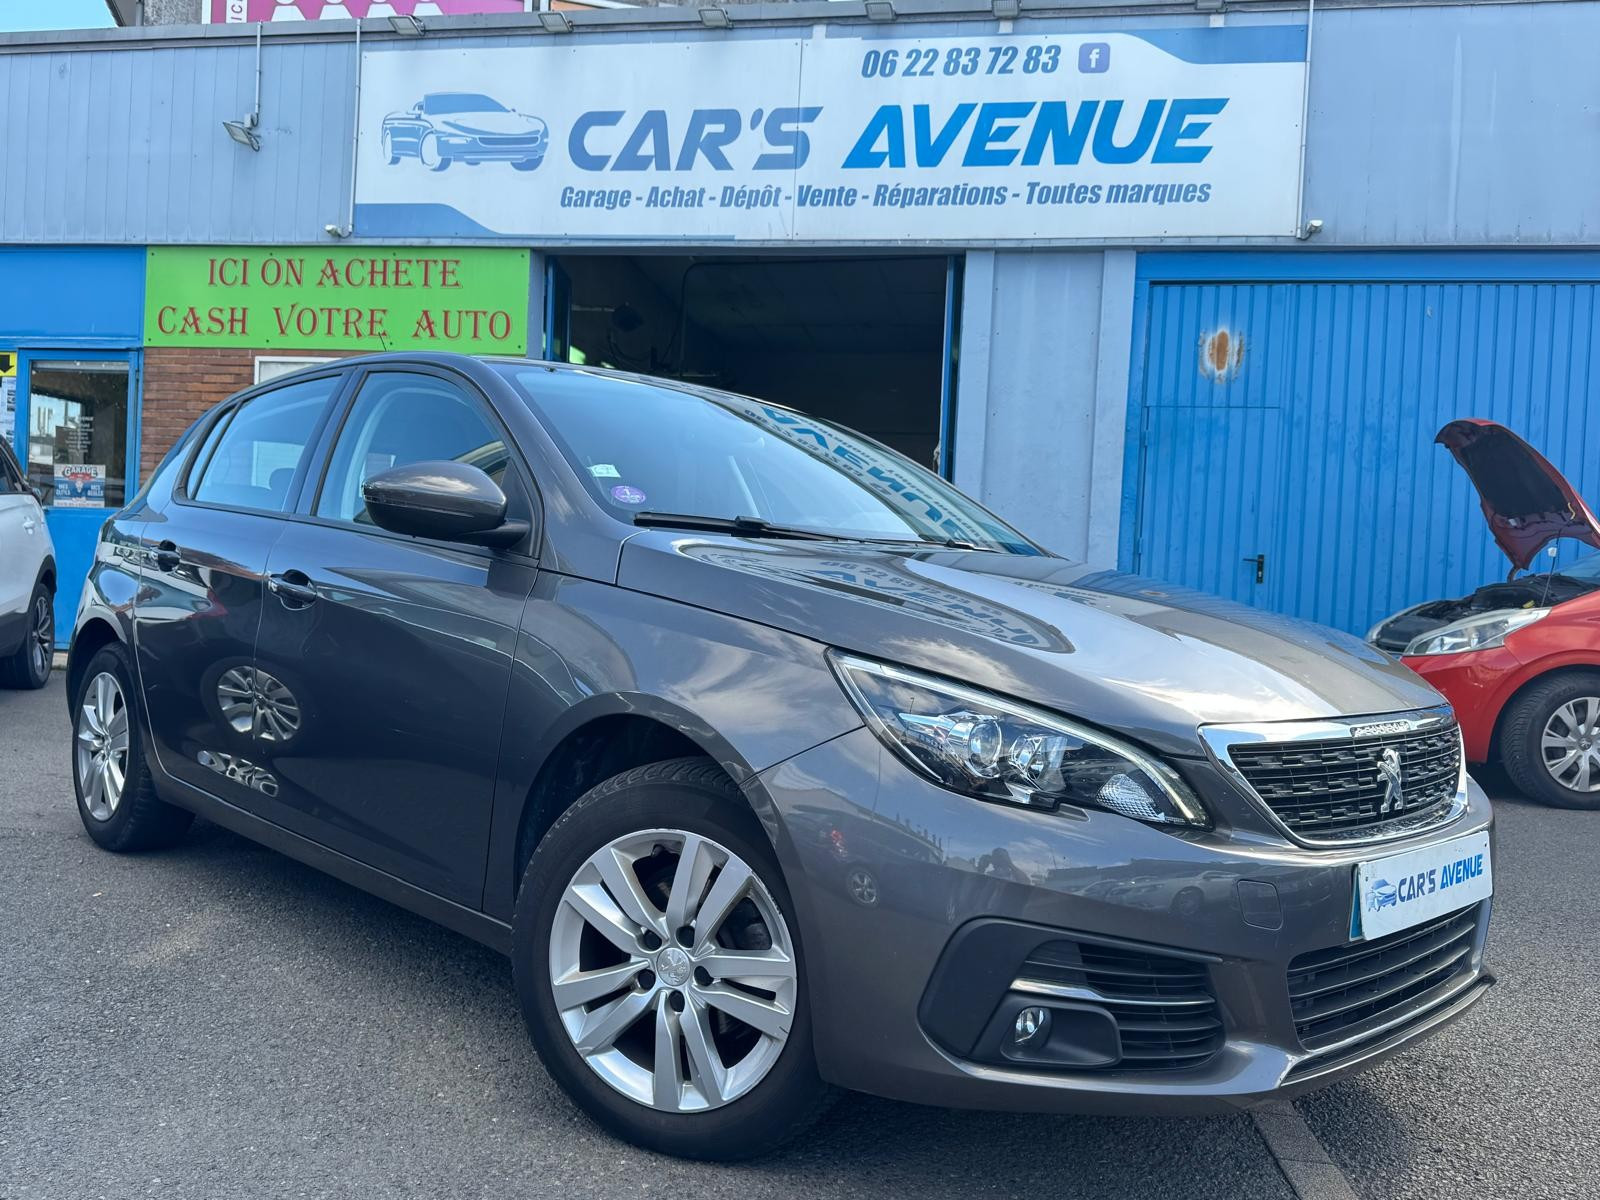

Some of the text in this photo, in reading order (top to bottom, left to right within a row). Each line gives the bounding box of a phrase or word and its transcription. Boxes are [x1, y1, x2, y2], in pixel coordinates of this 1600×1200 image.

[861, 45, 1061, 78] 06 22 83 72 83
[568, 98, 1230, 172] CAR'S AVENUE
[560, 185, 631, 211] Garage
[645, 185, 705, 209] Achat
[720, 184, 782, 210] Dépôt
[796, 184, 858, 208] Vente
[873, 182, 1008, 209] Réparations
[1025, 182, 1103, 206] Toutes
[1104, 183, 1211, 206] marques
[208, 258, 462, 289] ICI ON ACHETE
[157, 303, 512, 340] CASH VOTRE AUTO
[1398, 854, 1483, 903] CAR'S AVENUE
